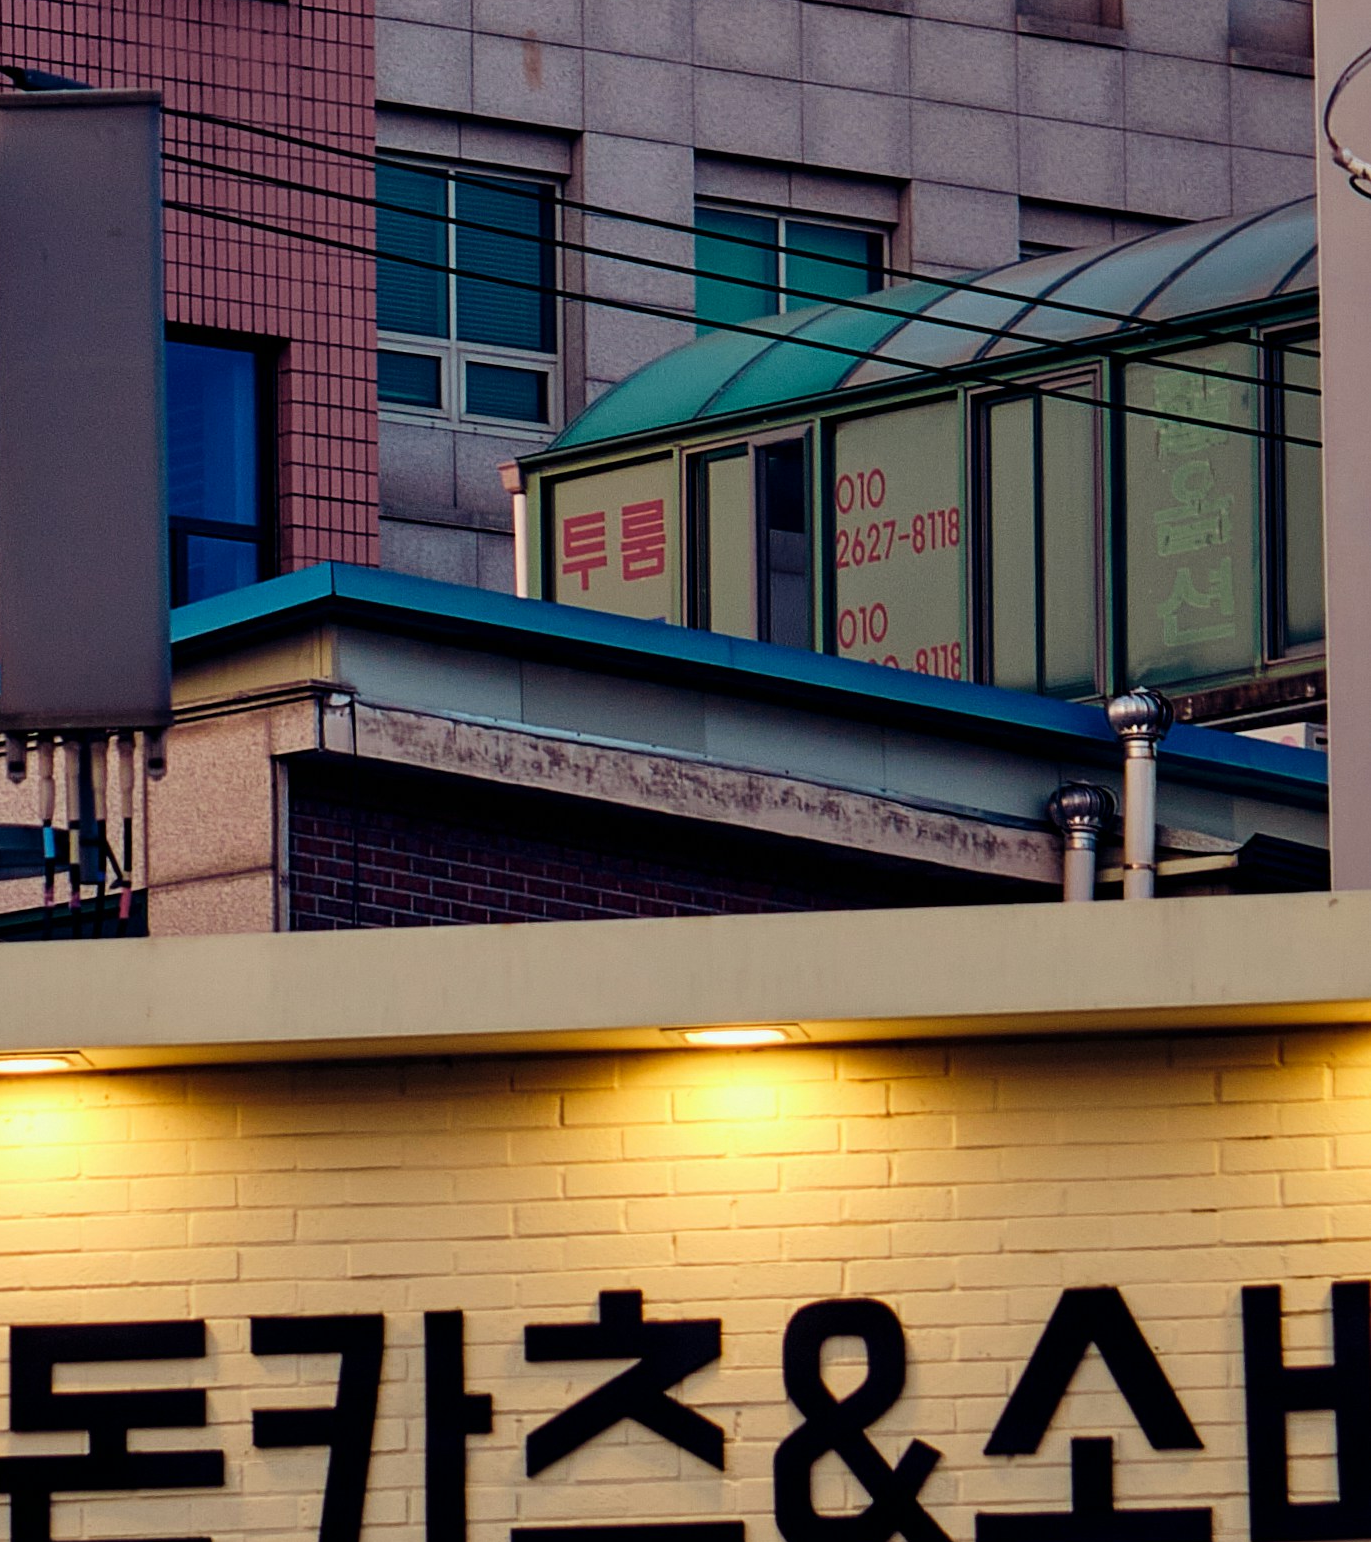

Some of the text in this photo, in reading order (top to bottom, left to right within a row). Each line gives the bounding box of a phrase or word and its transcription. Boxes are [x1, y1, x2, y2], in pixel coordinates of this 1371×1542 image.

[835, 468, 886, 514] 010
[562, 498, 666, 591] 투룸
[836, 506, 960, 570] 2627-8118
[837, 602, 888, 649] 010
